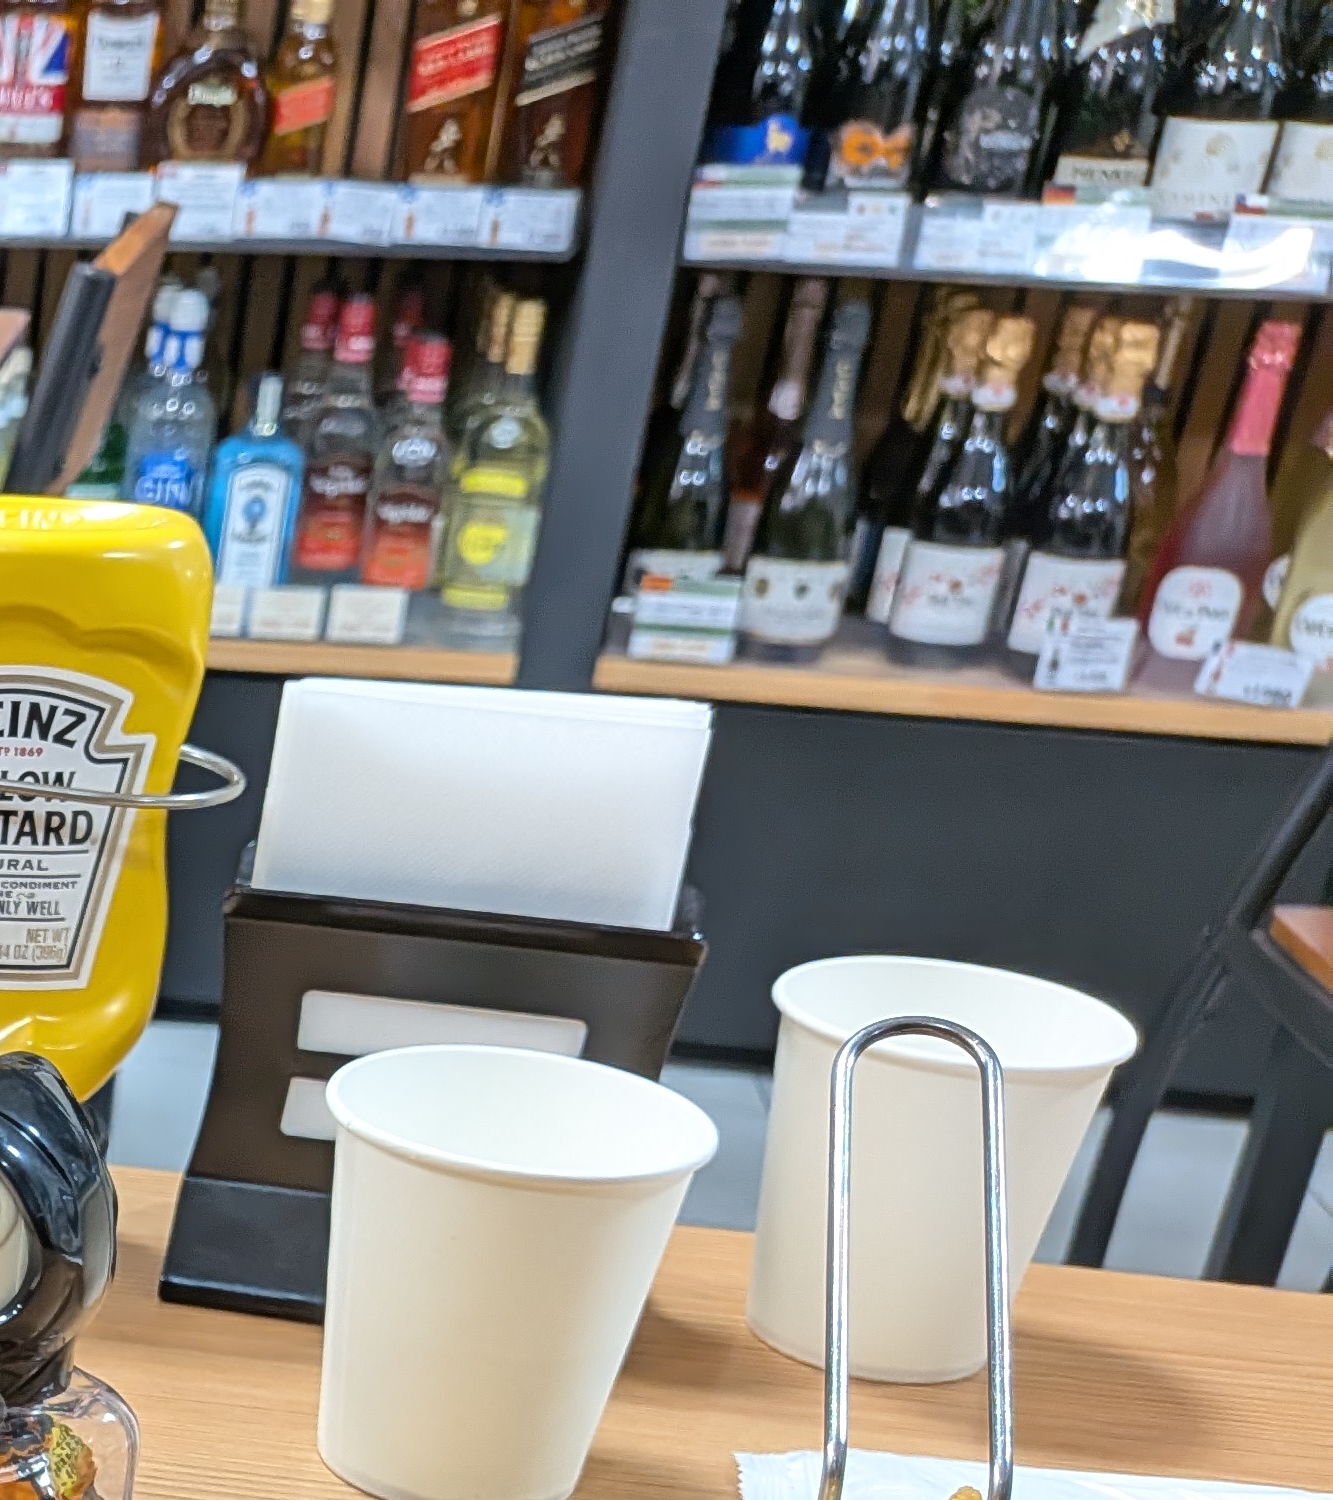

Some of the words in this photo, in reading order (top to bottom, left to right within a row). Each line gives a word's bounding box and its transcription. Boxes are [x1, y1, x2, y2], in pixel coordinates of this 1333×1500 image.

[14, 747, 43, 757] 1869
[0, 880, 78, 890] CONDIMENT
[26, 900, 61, 916] WELL
[26, 928, 47, 943] NET
